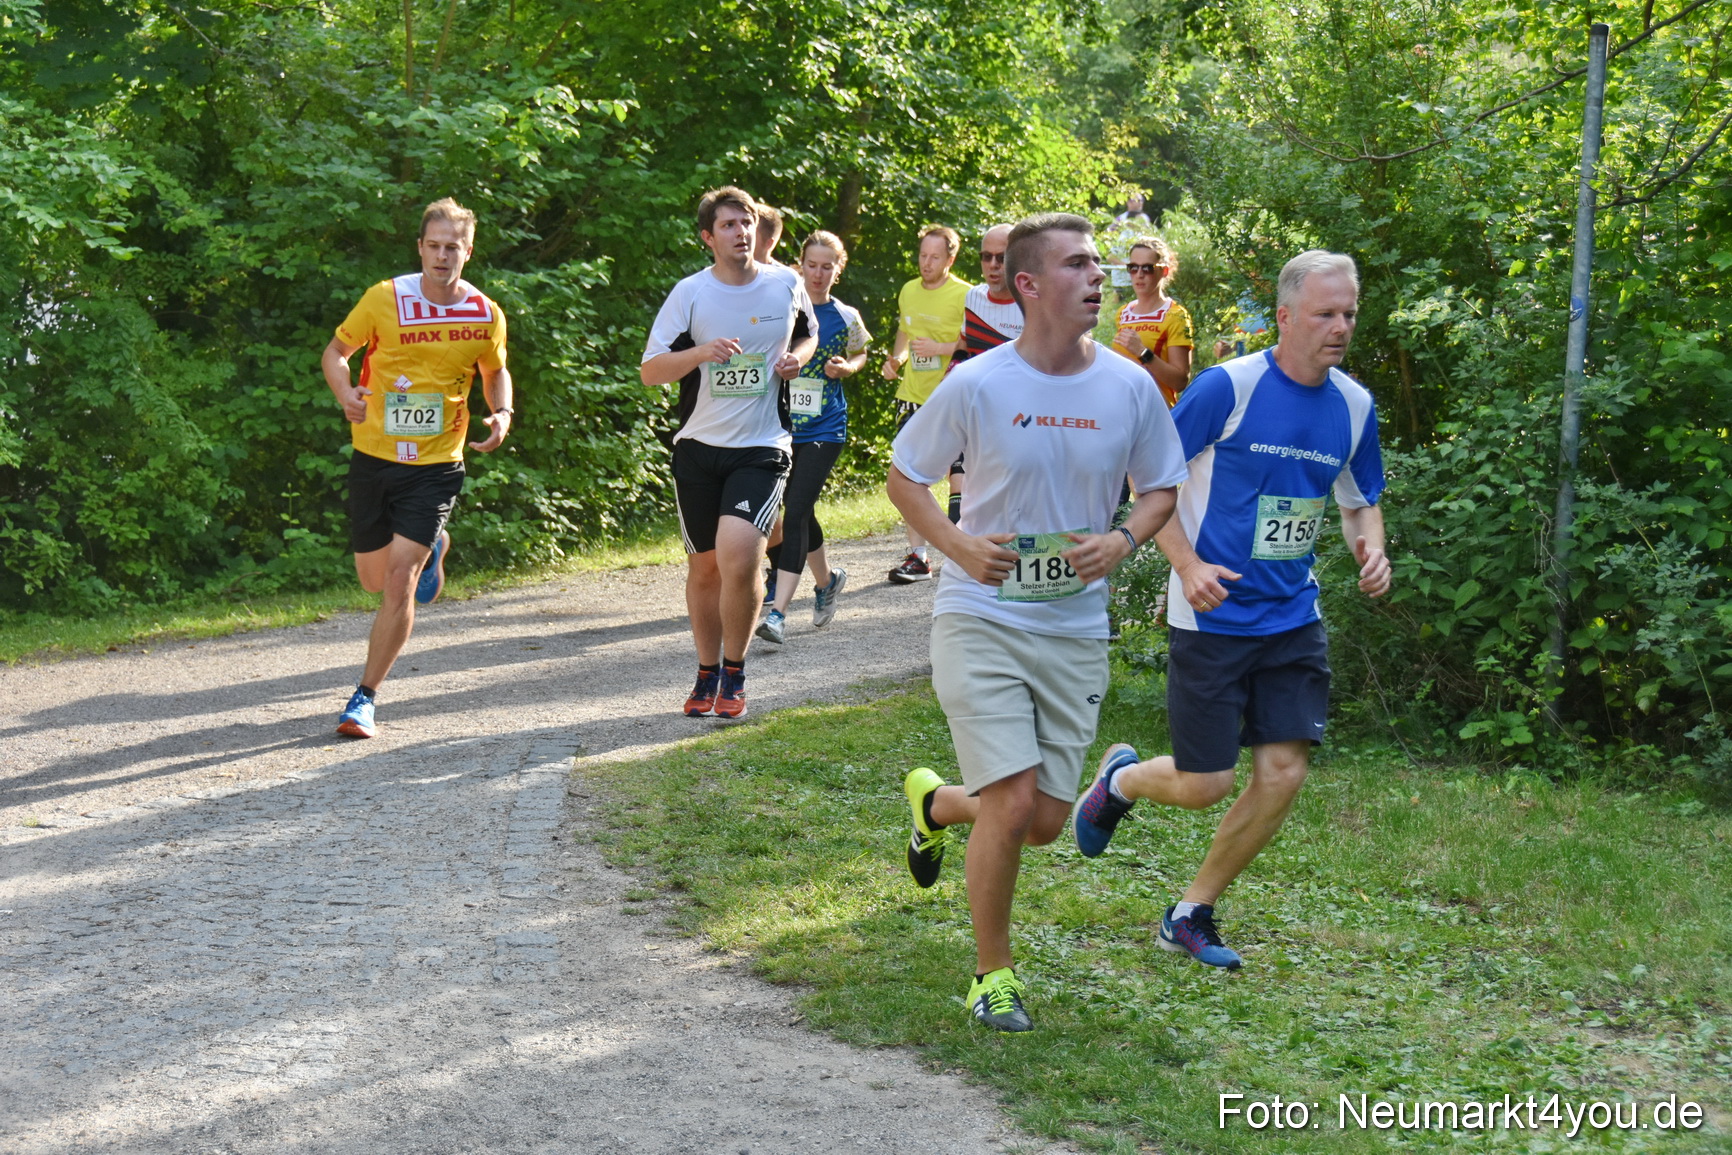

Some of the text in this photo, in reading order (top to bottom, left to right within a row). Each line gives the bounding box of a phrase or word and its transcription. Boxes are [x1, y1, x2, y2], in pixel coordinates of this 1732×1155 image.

[400, 326, 492, 345] MAX BÖGL
[1135, 324, 1161, 333] BÖGL
[715, 368, 760, 386] 2373
[792, 393, 812, 406] 139
[392, 408, 436, 424] 1702
[1036, 415, 1101, 430] KLEBL
[1249, 442, 1341, 467] energiegeladen
[1264, 519, 1316, 542] 2158
[1015, 556, 1077, 582] 1188
[1047, 579, 1071, 588] Fabian
